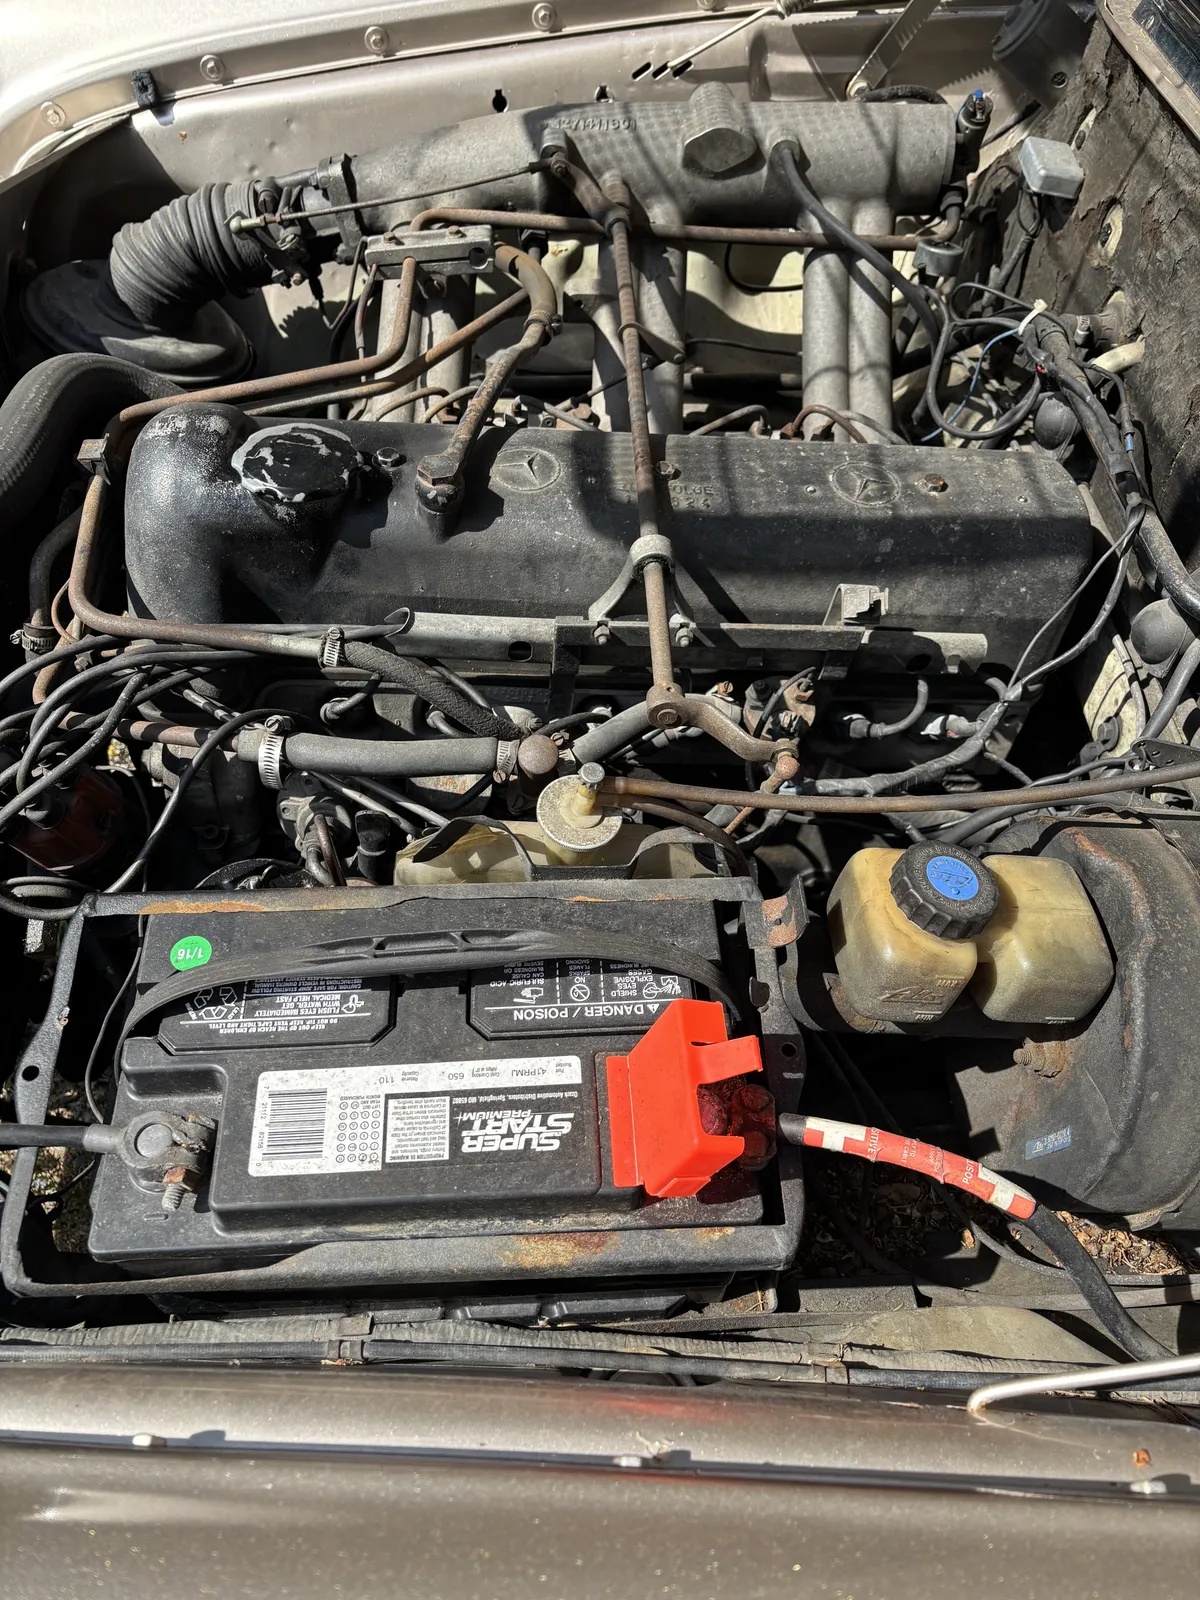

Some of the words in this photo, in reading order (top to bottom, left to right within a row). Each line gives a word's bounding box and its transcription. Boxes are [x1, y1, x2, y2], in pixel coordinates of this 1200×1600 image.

[177, 946, 204, 960] 1/16
[614, 975, 653, 983] EXPLOSIVE
[228, 1006, 239, 1020] LEAD
[254, 1009, 299, 1017] IMMEDIATELY
[514, 1008, 568, 1021] POISON
[584, 1004, 644, 1017] DANGER
[512, 1067, 546, 1076] 41PRMJ
[463, 1109, 531, 1120] PREMIUM
[461, 1113, 574, 1136] START
[461, 1132, 560, 1153] SUPER
